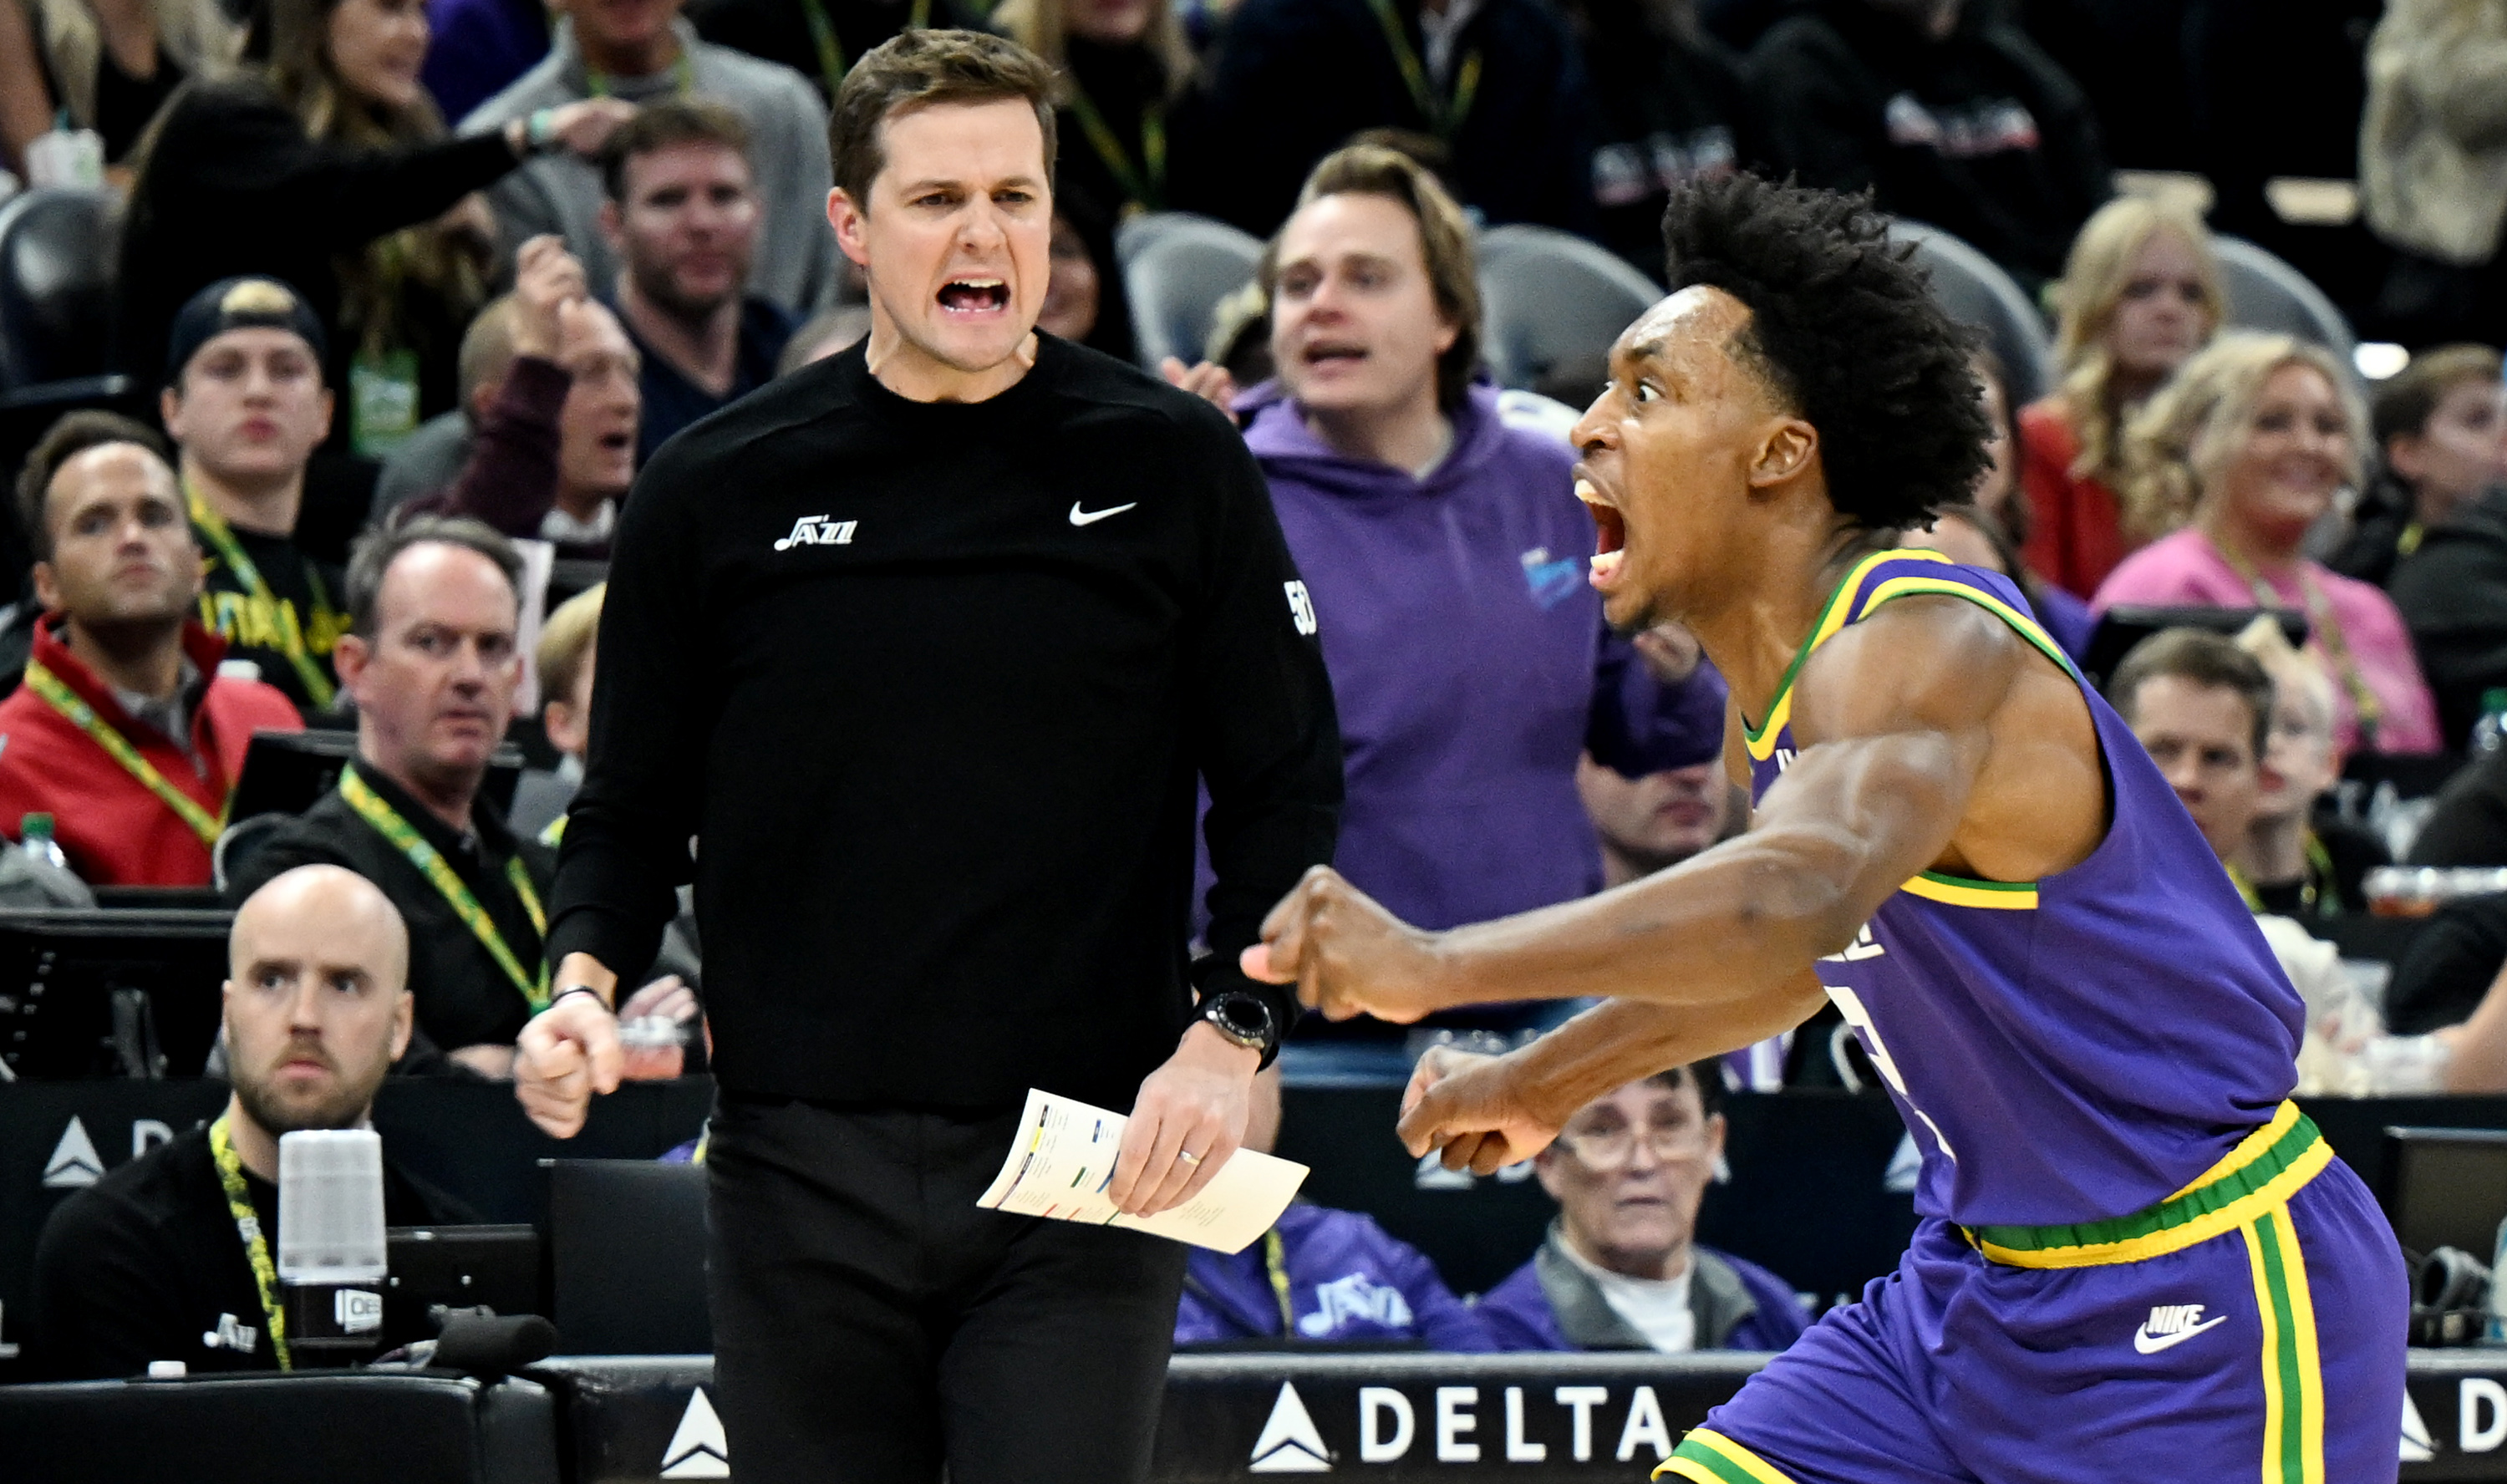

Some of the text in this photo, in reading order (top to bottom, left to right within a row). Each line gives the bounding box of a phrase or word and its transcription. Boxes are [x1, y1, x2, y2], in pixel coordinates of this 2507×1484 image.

[774, 514, 858, 551] JAZZ
[2146, 1304, 2205, 1334] NIKE
[1360, 1386, 1672, 1462] DELTA
